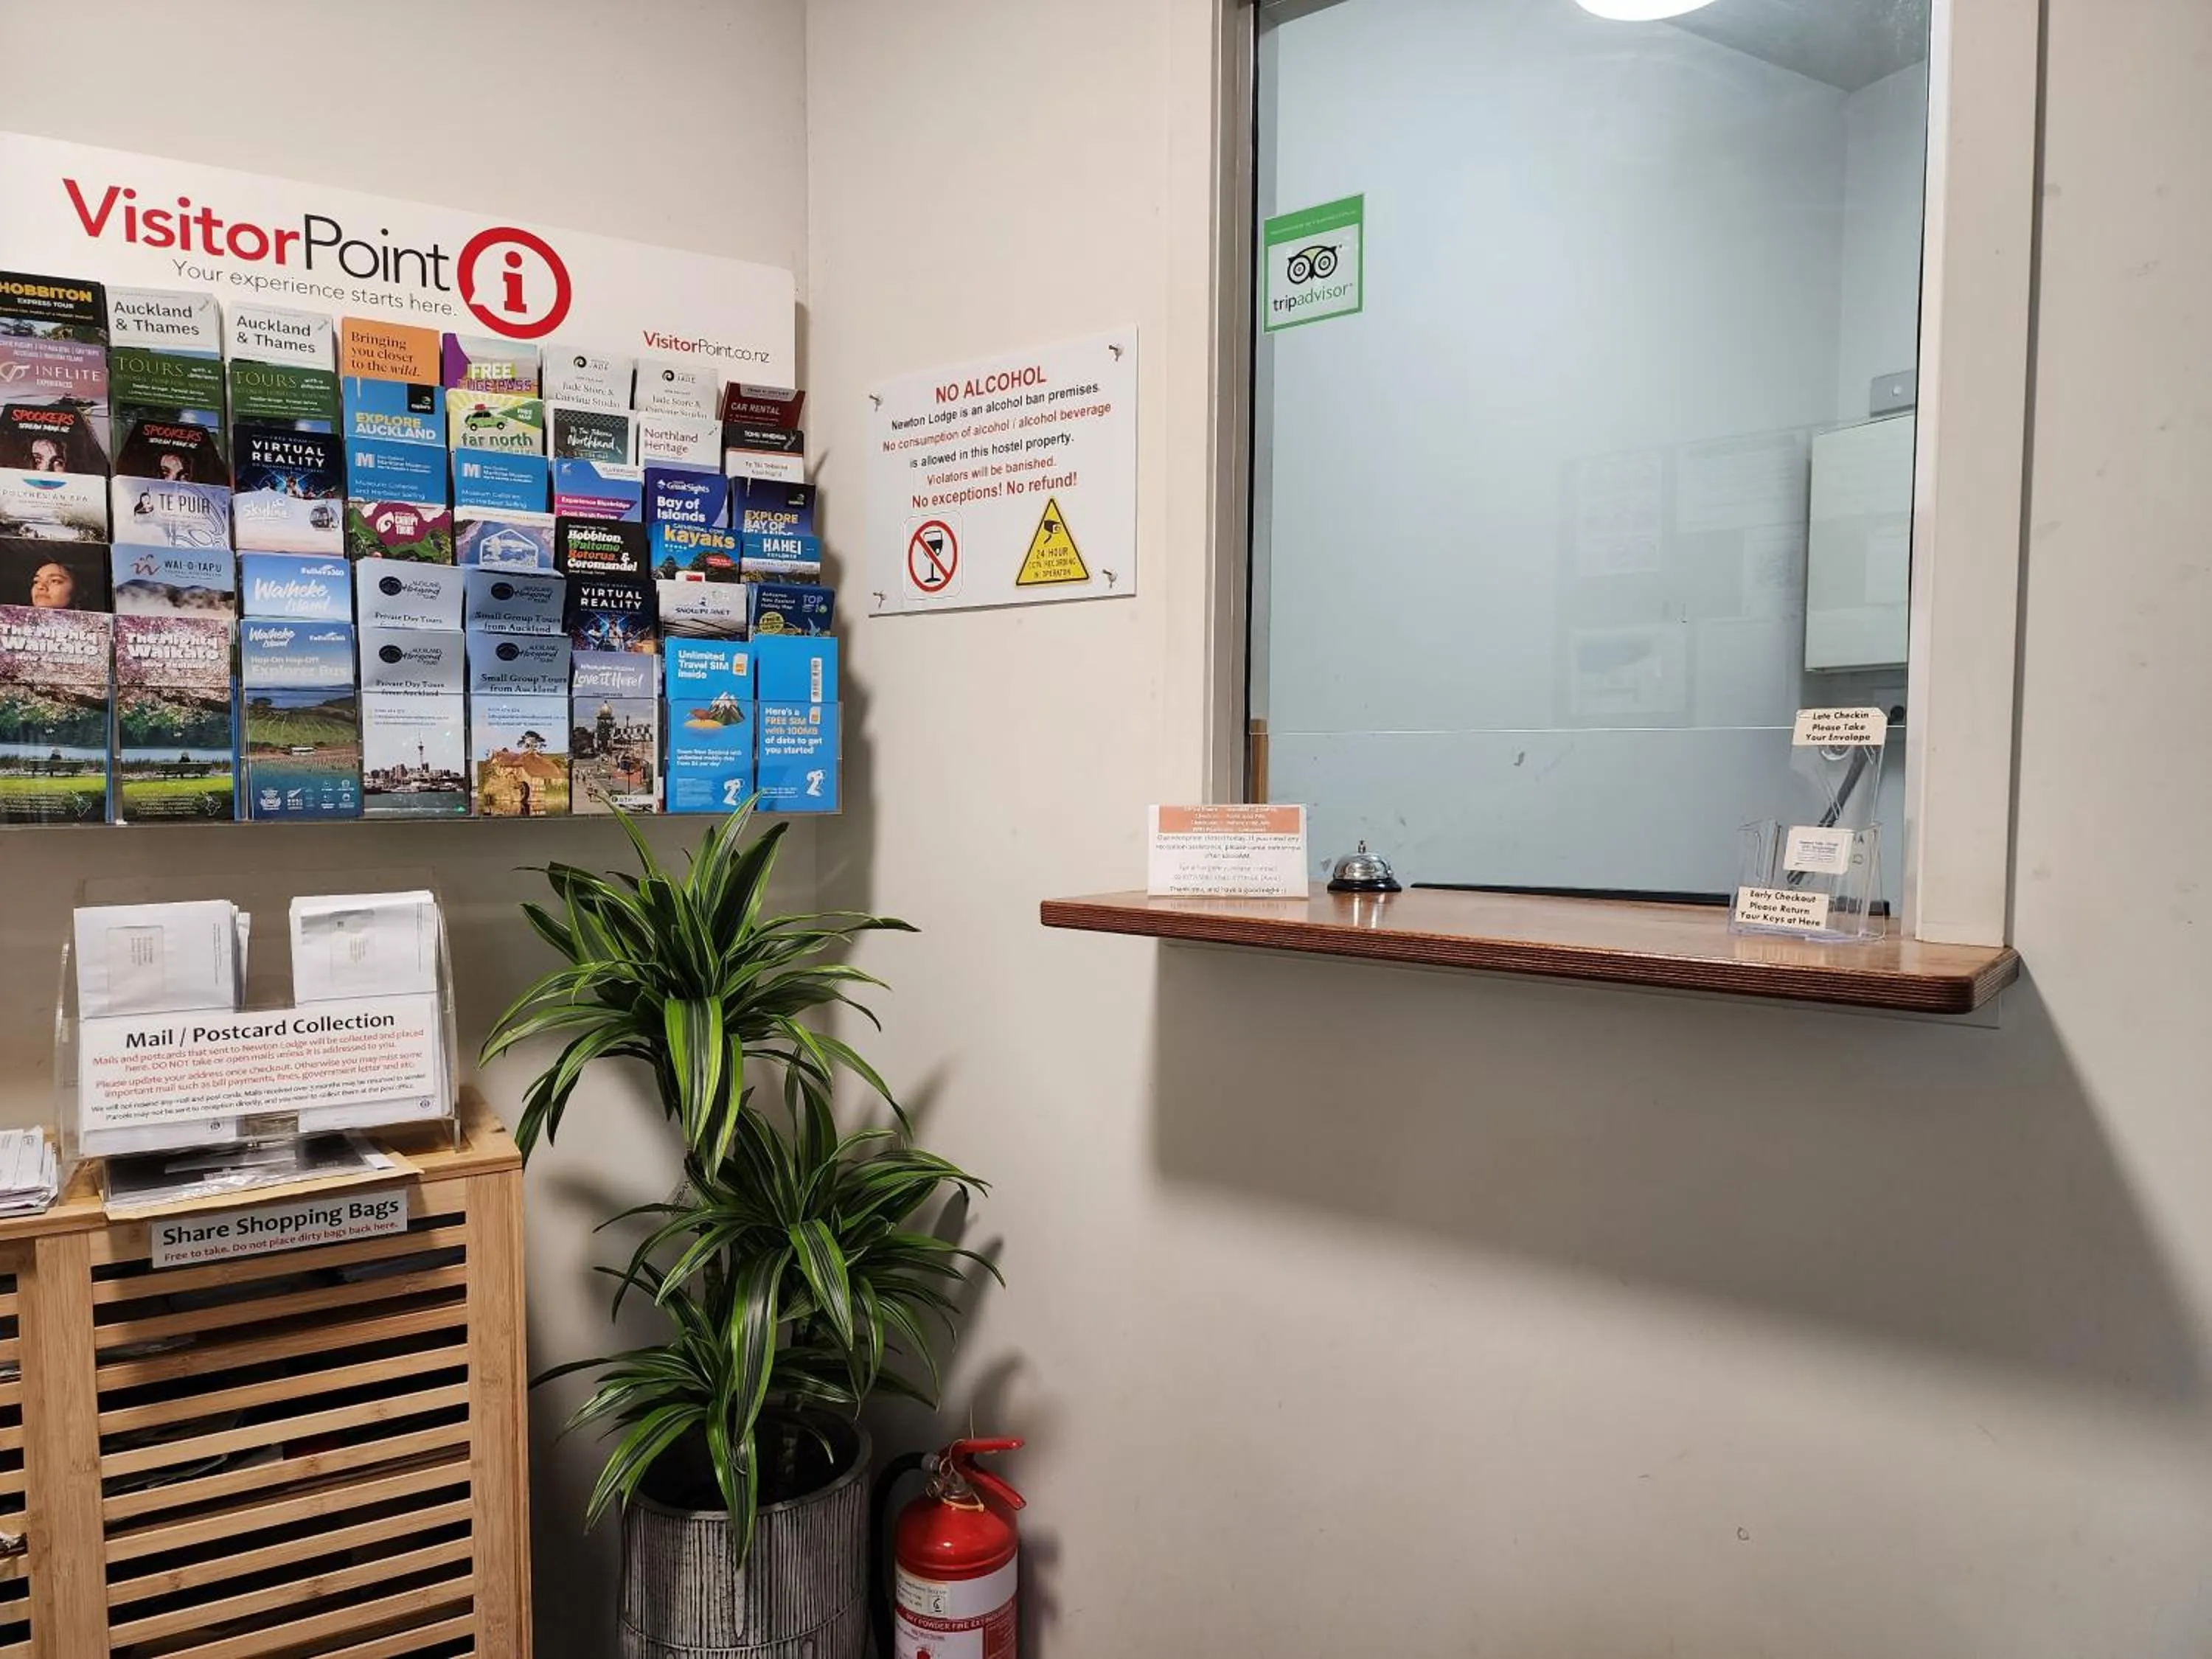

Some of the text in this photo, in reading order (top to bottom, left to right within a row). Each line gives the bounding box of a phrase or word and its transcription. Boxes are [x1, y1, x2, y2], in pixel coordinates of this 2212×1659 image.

[63, 178, 450, 291] VisitorPoint
[0, 282, 92, 303] HOBBITON
[173, 259, 458, 316] Your experience starts here.
[1273, 284, 1349, 312] tripadvisor
[114, 301, 192, 319] Auckland
[116, 319, 200, 336] & Thames
[237, 316, 311, 336] Auckland
[236, 332, 316, 353] & Thames
[351, 331, 406, 349] Bringing
[644, 330, 770, 363] VisitorPoint.co.nz
[351, 347, 413, 363] you closer
[35, 364, 102, 382] INFLITE
[114, 356, 184, 378] TOURS
[351, 359, 421, 377] to the wild.
[472, 363, 512, 379] FREE
[236, 371, 296, 388] TOURS
[935, 366, 1046, 404] NO ALCOHOL
[891, 383, 1099, 431] Newton Lodge an alcohol ban premises
[12, 409, 74, 425] SPOOKERS
[355, 413, 422, 428] EXPLORE
[143, 424, 202, 441] SPOOKERS
[355, 423, 437, 440] AUCKLAND
[644, 428, 698, 443] Northland
[883, 403, 1111, 452] No consumption alcohol alcohol beverage
[462, 432, 532, 446] far north
[251, 440, 325, 456] VIRTUAL
[644, 441, 689, 454] Heritage
[921, 432, 1074, 467] allowed in this hostel property.
[252, 452, 325, 467] REALITY
[927, 456, 1057, 486] Violators will be banished.
[912, 471, 1077, 509] No exceptions! No refund!
[159, 494, 211, 515] TE PUIA
[657, 496, 699, 510] Bay of
[657, 509, 706, 522] Islands
[745, 509, 799, 524] EXPLORE
[744, 520, 766, 531] BAY
[664, 525, 735, 549] kayaks
[763, 538, 801, 554] HAHEI
[1036, 548, 1068, 559] 24 HOUR
[567, 559, 637, 571] Coromandel
[254, 577, 330, 601] Waiheke
[580, 588, 642, 599] VIRTUAL
[580, 598, 642, 610] REALITY
[802, 594, 823, 603] TOP
[474, 612, 533, 625] Small Group
[248, 627, 295, 642] Waiheke
[484, 623, 551, 633] from Auckland
[1, 636, 98, 655] Waikato
[129, 644, 219, 660] Waikato
[678, 650, 725, 661] Unlimited
[678, 659, 729, 670] Travel SIM
[481, 674, 508, 683] Small
[509, 675, 538, 686] Group
[678, 669, 707, 679] Inside
[490, 684, 557, 694] from Auckland
[765, 707, 792, 717] Here's
[1813, 712, 1869, 720] Late Checkin
[765, 726, 786, 734] with
[1829, 734, 1871, 742] Envelope
[776, 737, 796, 745] data
[807, 738, 822, 746] get
[765, 745, 815, 755] you started
[1750, 890, 1816, 903] Early Checkout
[1750, 902, 1810, 915] Please Return
[1740, 911, 1820, 927] Your Keys Here
[126, 1013, 394, 1048] Mail Postcard Collection
[92, 1029, 424, 1066] Mails and postcards that sent will collected placed
[151, 1062, 167, 1070] DO
[192, 1058, 212, 1067] take
[322, 1043, 366, 1055] addressed
[96, 1057, 340, 1089] Please update your address once Otherwise
[104, 1065, 380, 1099] important mail such government letter
[163, 1200, 400, 1246] Share Shopping Bags
[164, 1221, 398, 1262] Free take. place dirty bags back here.
